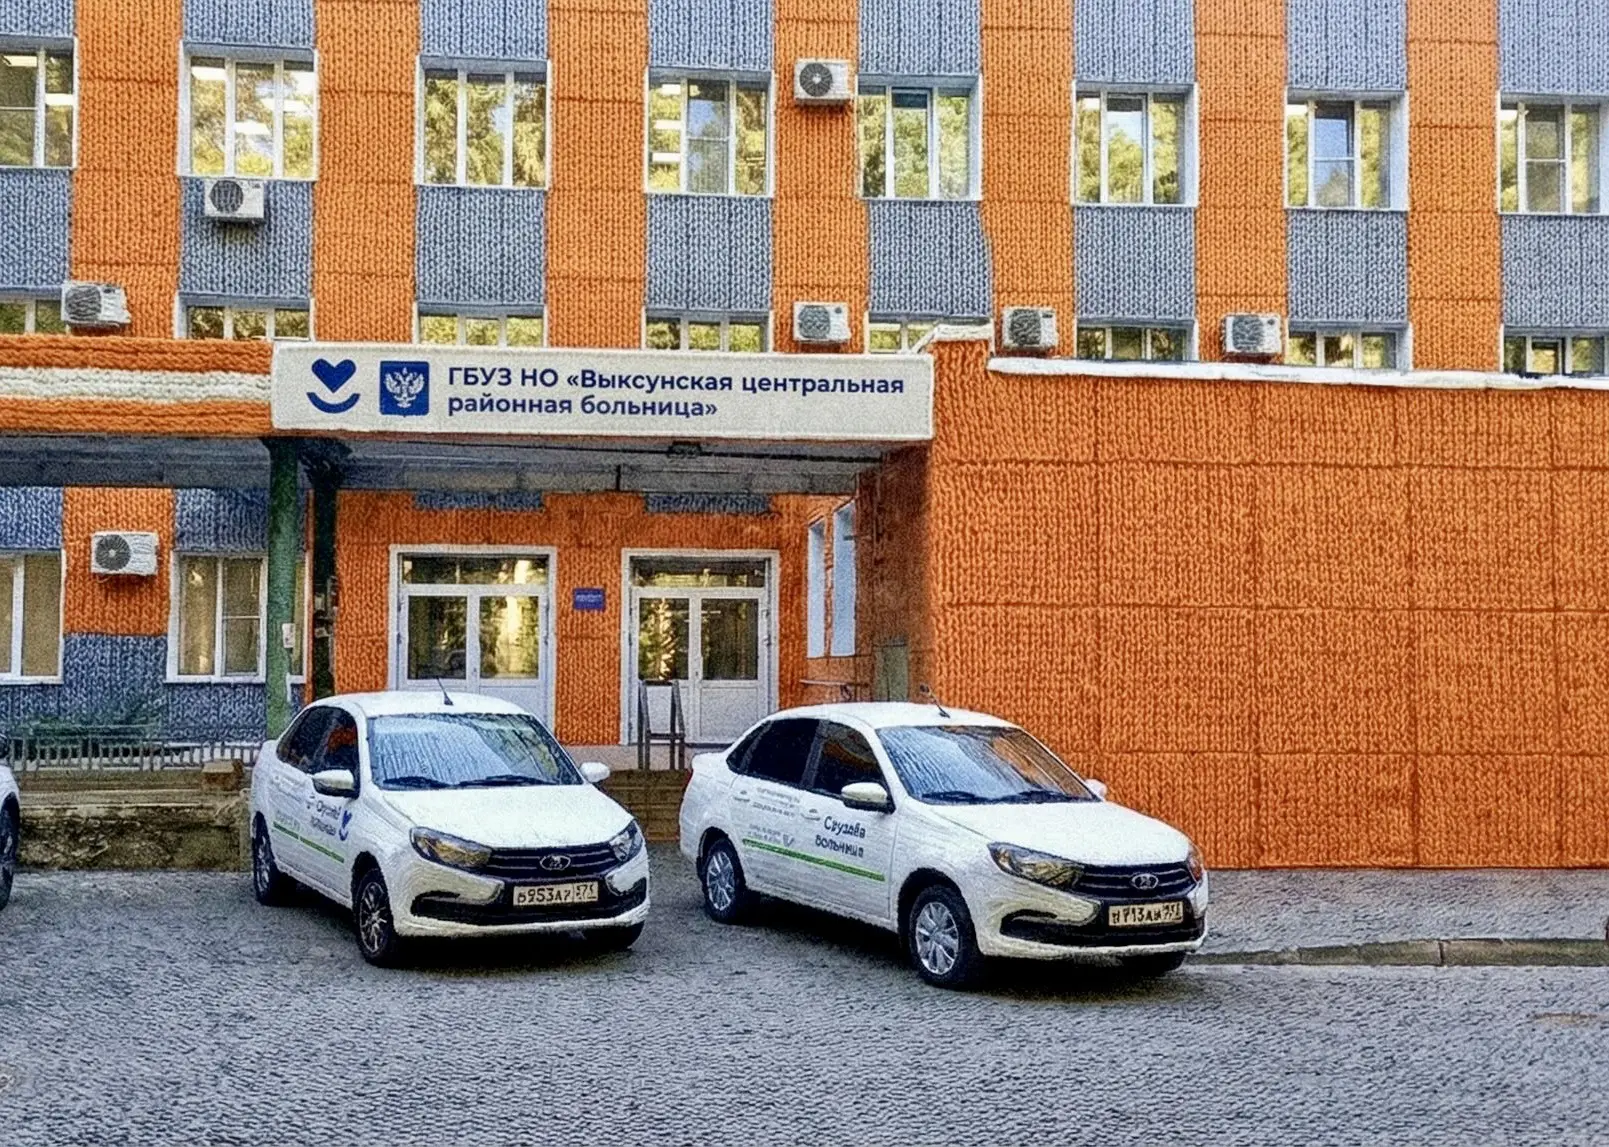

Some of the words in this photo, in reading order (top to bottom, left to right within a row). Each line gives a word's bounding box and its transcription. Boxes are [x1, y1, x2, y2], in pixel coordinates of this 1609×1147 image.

[448, 366, 512, 386] ГБУЗ
[520, 368, 559, 387] НО
[567, 370, 733, 394] «Выксунская
[743, 377, 904, 397] центральная
[448, 392, 572, 417] районная
[581, 395, 718, 419] больница»
